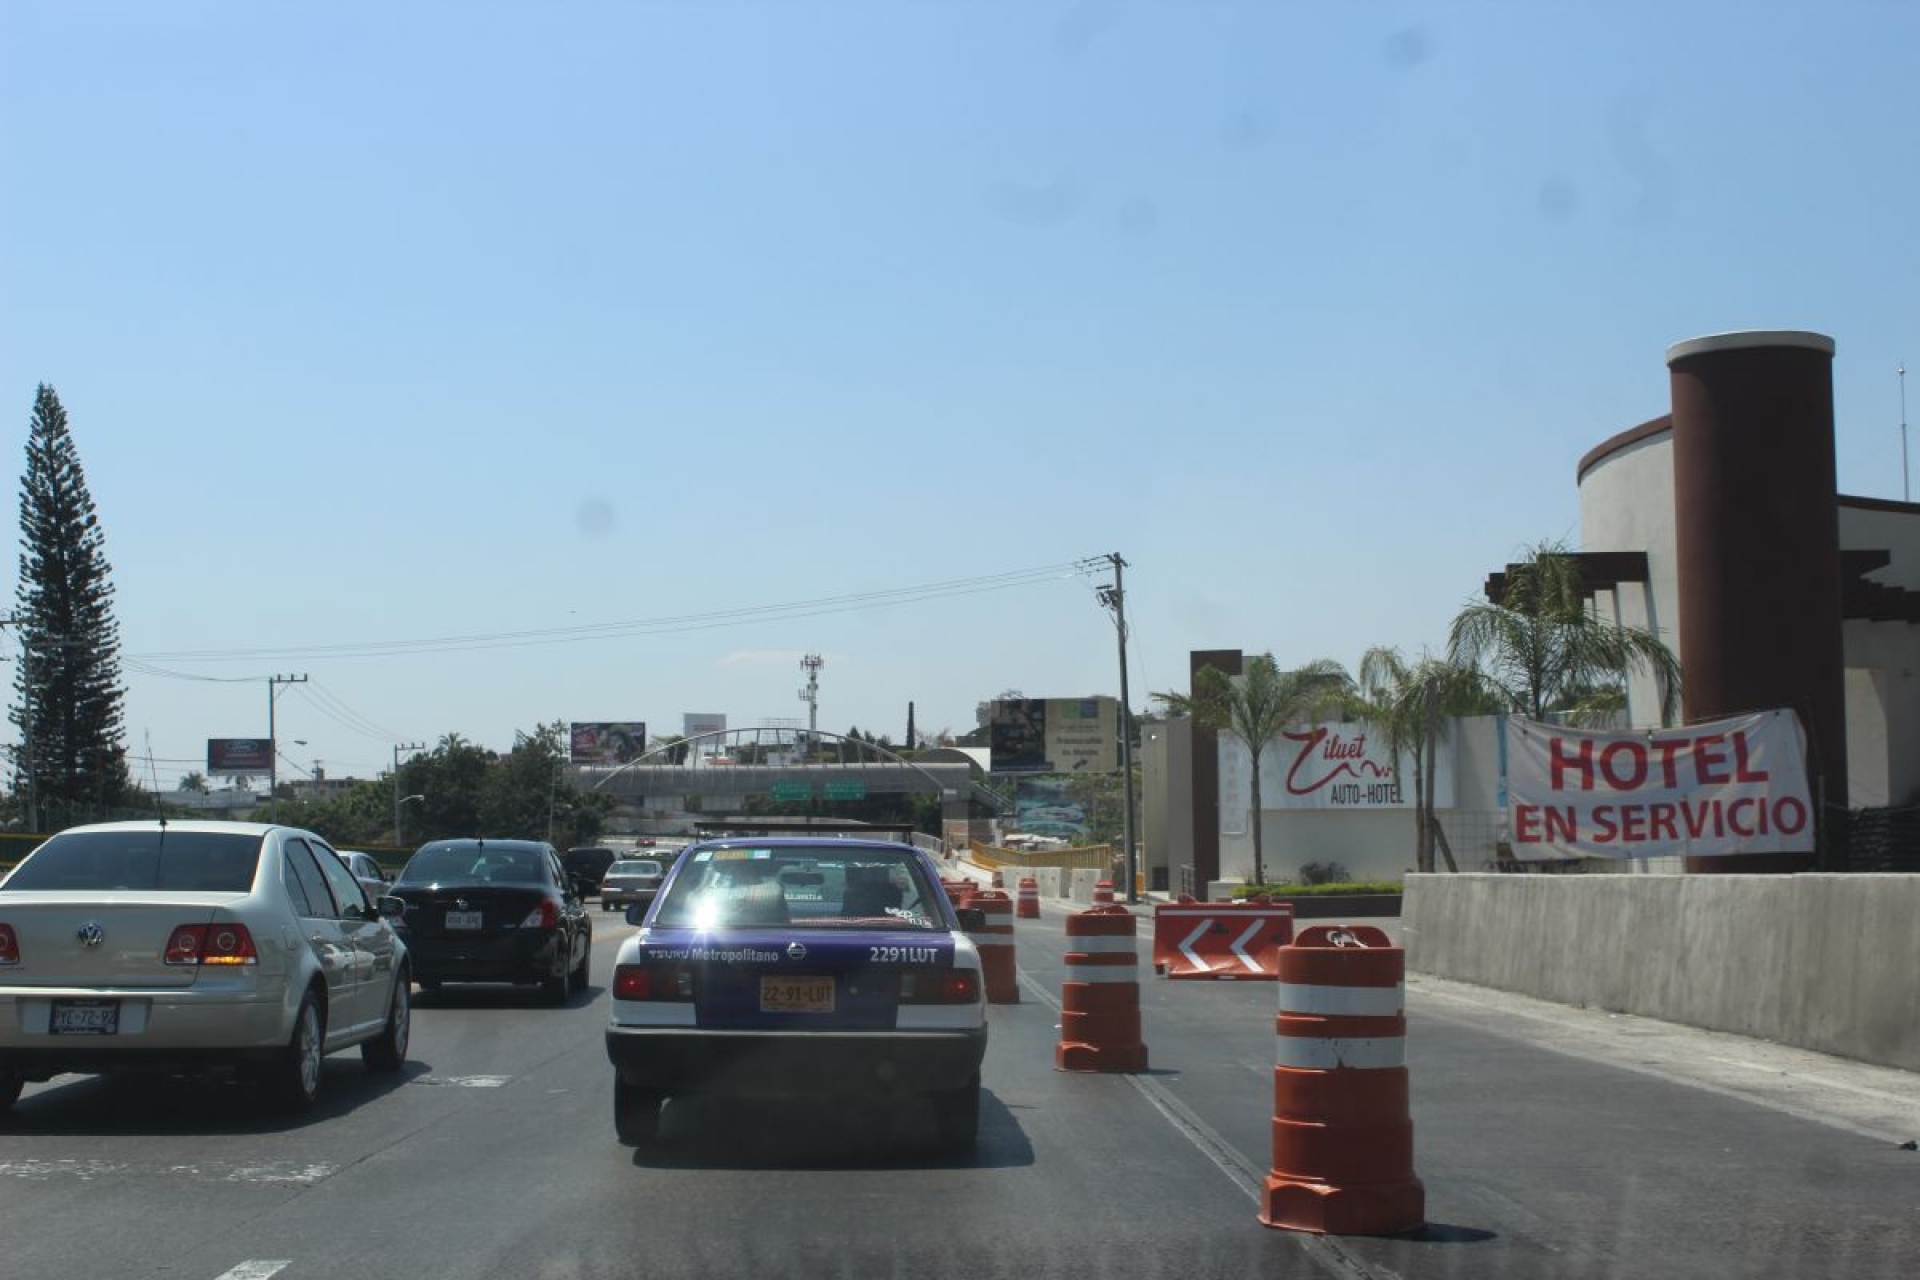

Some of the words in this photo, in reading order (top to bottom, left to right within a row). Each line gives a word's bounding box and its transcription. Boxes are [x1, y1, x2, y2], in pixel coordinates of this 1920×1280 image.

[1549, 731, 1768, 792] HOTEL
[1331, 783, 1404, 804] AUTO-HOTEL
[1515, 804, 1577, 844] EN
[1591, 796, 1807, 843] SERVICIO
[692, 947, 779, 964] Metropolitano
[869, 946, 939, 963] 2291LUT
[763, 984, 832, 1002] 22-91-LUT
